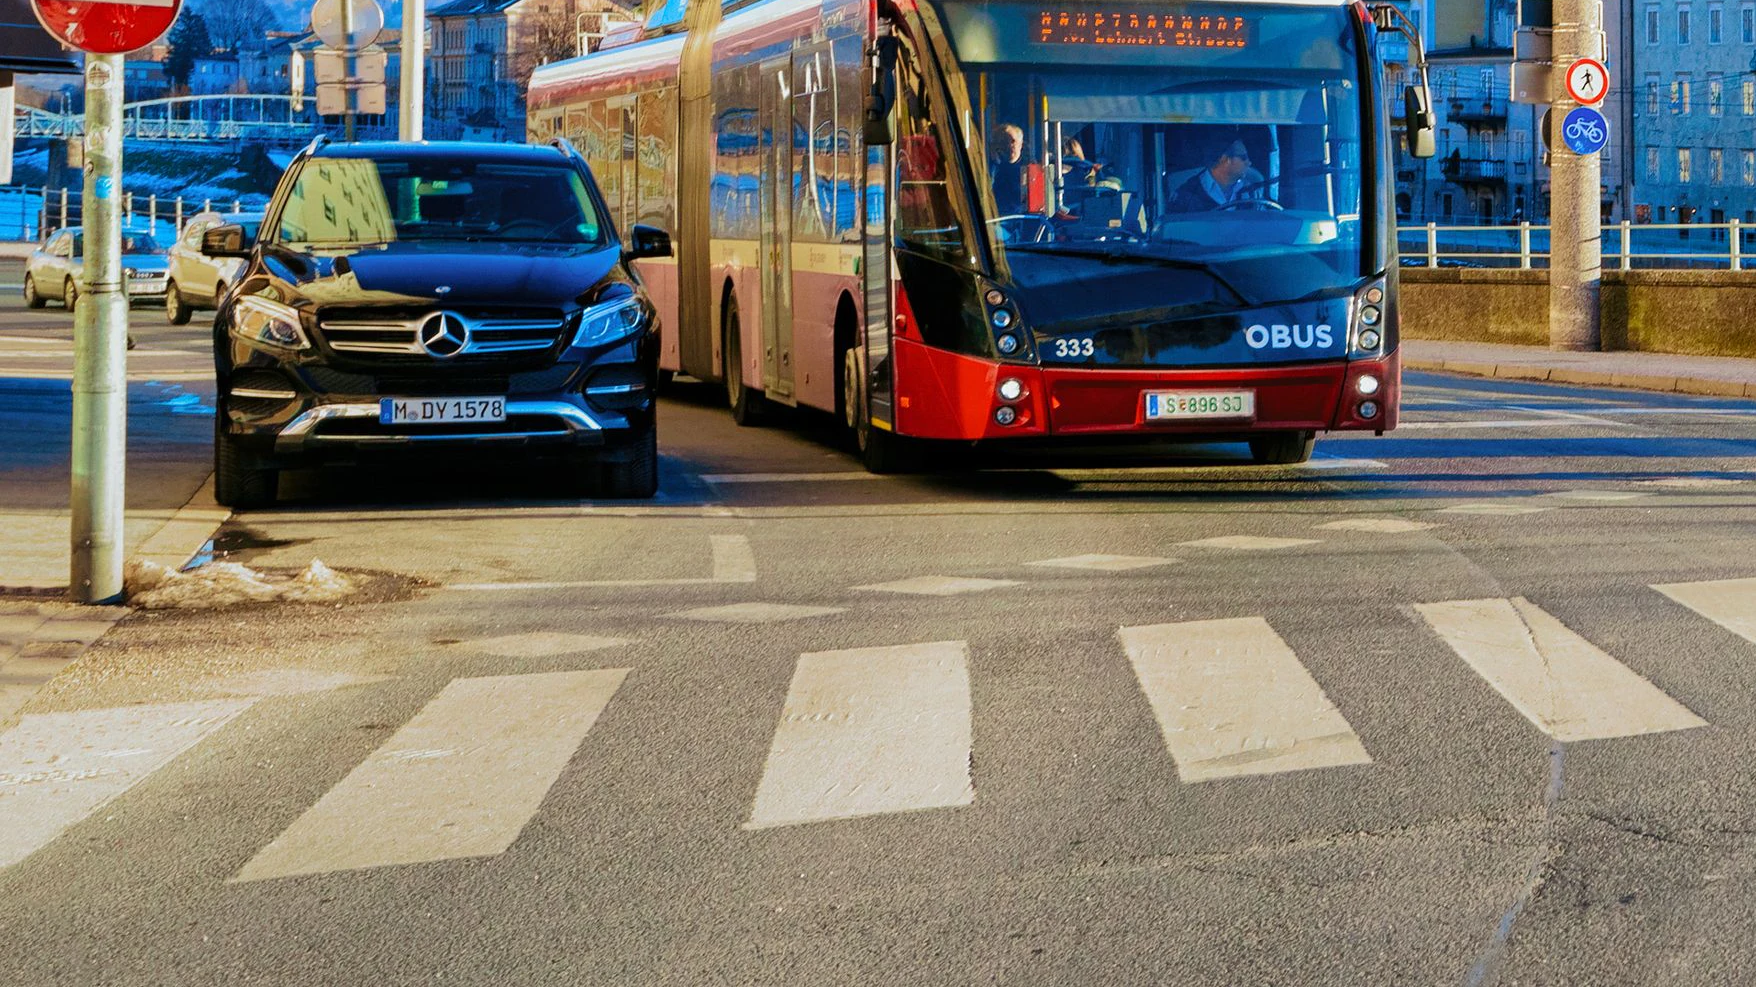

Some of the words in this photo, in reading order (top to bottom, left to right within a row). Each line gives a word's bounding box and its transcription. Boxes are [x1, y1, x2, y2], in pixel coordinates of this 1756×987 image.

[1245, 324, 1333, 350] OBUS
[1055, 338, 1095, 358] 333
[394, 401, 407, 420] M
[421, 400, 448, 420] DY
[452, 399, 503, 419] 1578
[1167, 397, 1176, 414] S
[1188, 396, 1218, 413] 896
[1223, 395, 1243, 412] SJ
